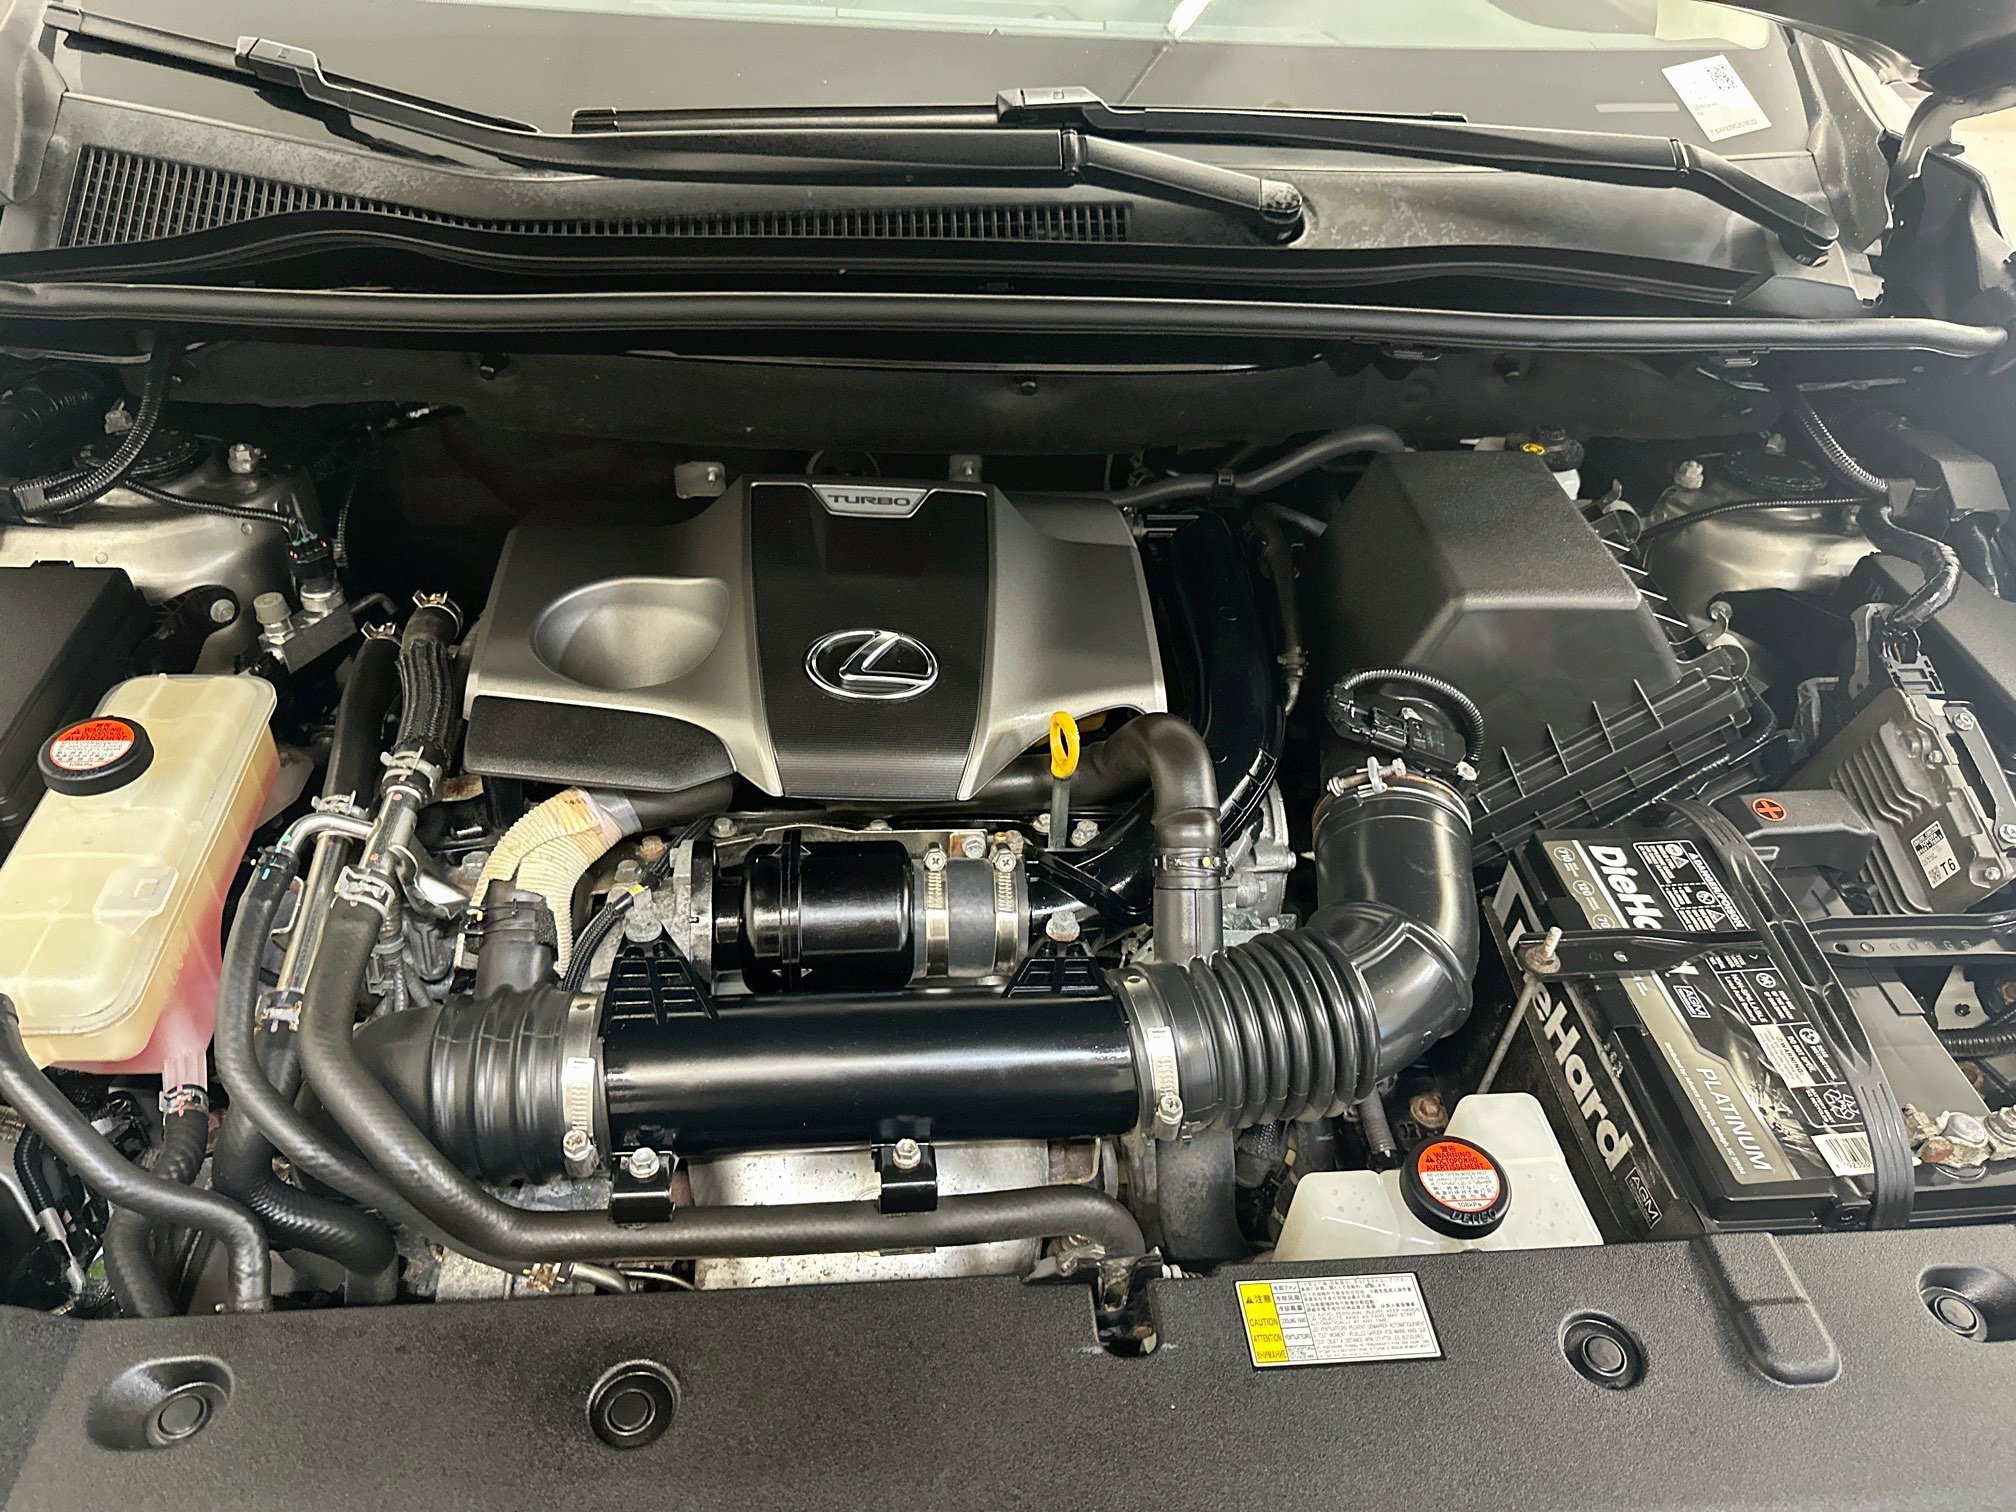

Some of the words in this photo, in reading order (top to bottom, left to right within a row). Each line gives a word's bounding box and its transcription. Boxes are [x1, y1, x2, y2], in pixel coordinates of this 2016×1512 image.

[827, 494, 911, 506] TURBO
[1558, 849, 1572, 863] 710
[1940, 858, 1956, 876] T6
[1577, 882, 1592, 897] 120
[1693, 859, 1745, 928] DANGER/POISON
[1683, 987, 1708, 1016] AGM
[1730, 974, 1769, 1023] NON-SPILLABLE
[1787, 1036, 1798, 1045] DO
[1793, 1045, 1805, 1056] NOT
[1696, 1068, 1773, 1170] PLATINUM
[1433, 1151, 1472, 1159] WARNING
[1426, 1162, 1484, 1172] AVERTISSEMENT
[1630, 1175, 1660, 1221] AGM
[1450, 1209, 1498, 1224] DENSO
[1254, 1294, 1272, 1304] 注意
[1249, 1318, 1278, 1327] CAUTION
[1254, 1333, 1283, 1343] ATTENTION
